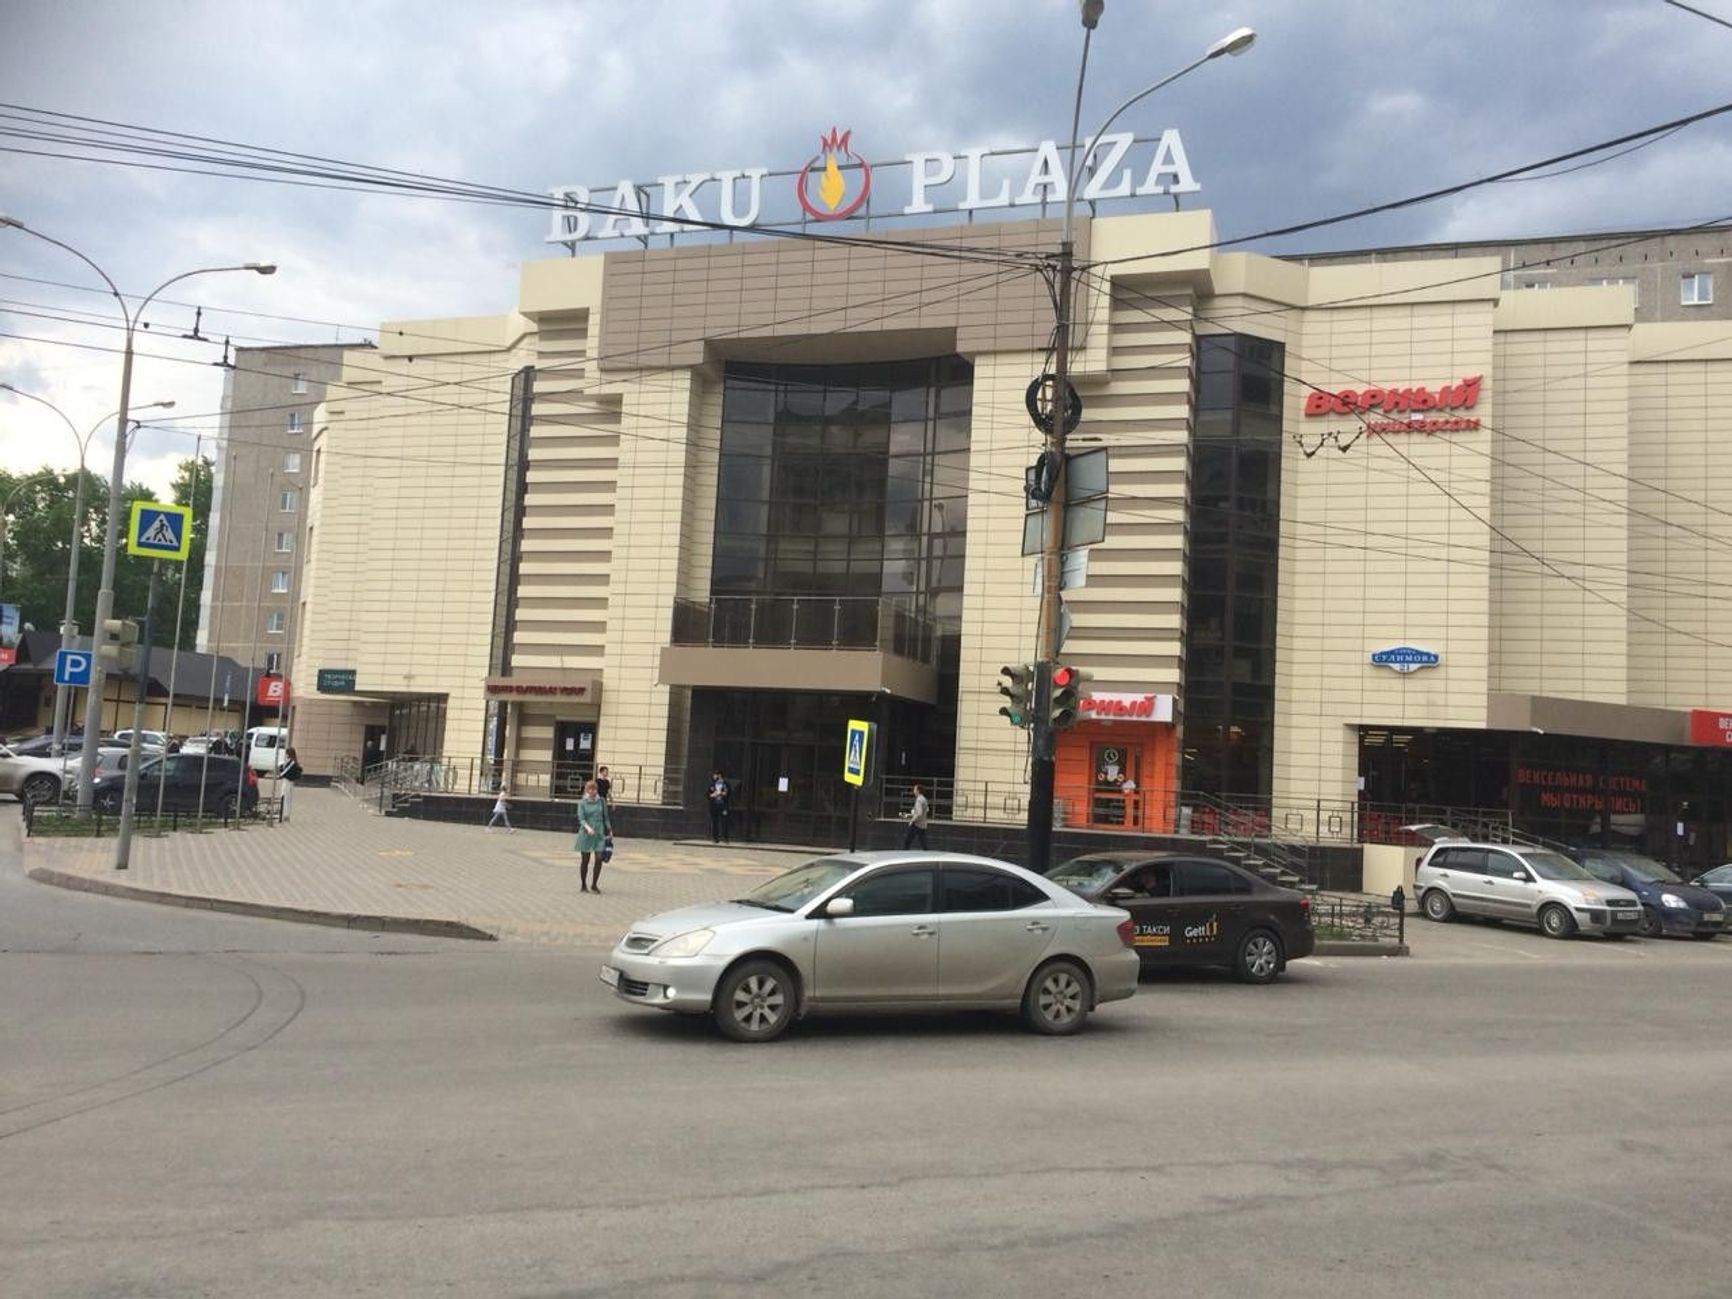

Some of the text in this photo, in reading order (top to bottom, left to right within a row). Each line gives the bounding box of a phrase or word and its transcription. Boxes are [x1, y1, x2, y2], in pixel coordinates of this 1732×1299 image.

[545, 128, 1201, 243] BAKU PLAZA
[64, 654, 87, 681] P
